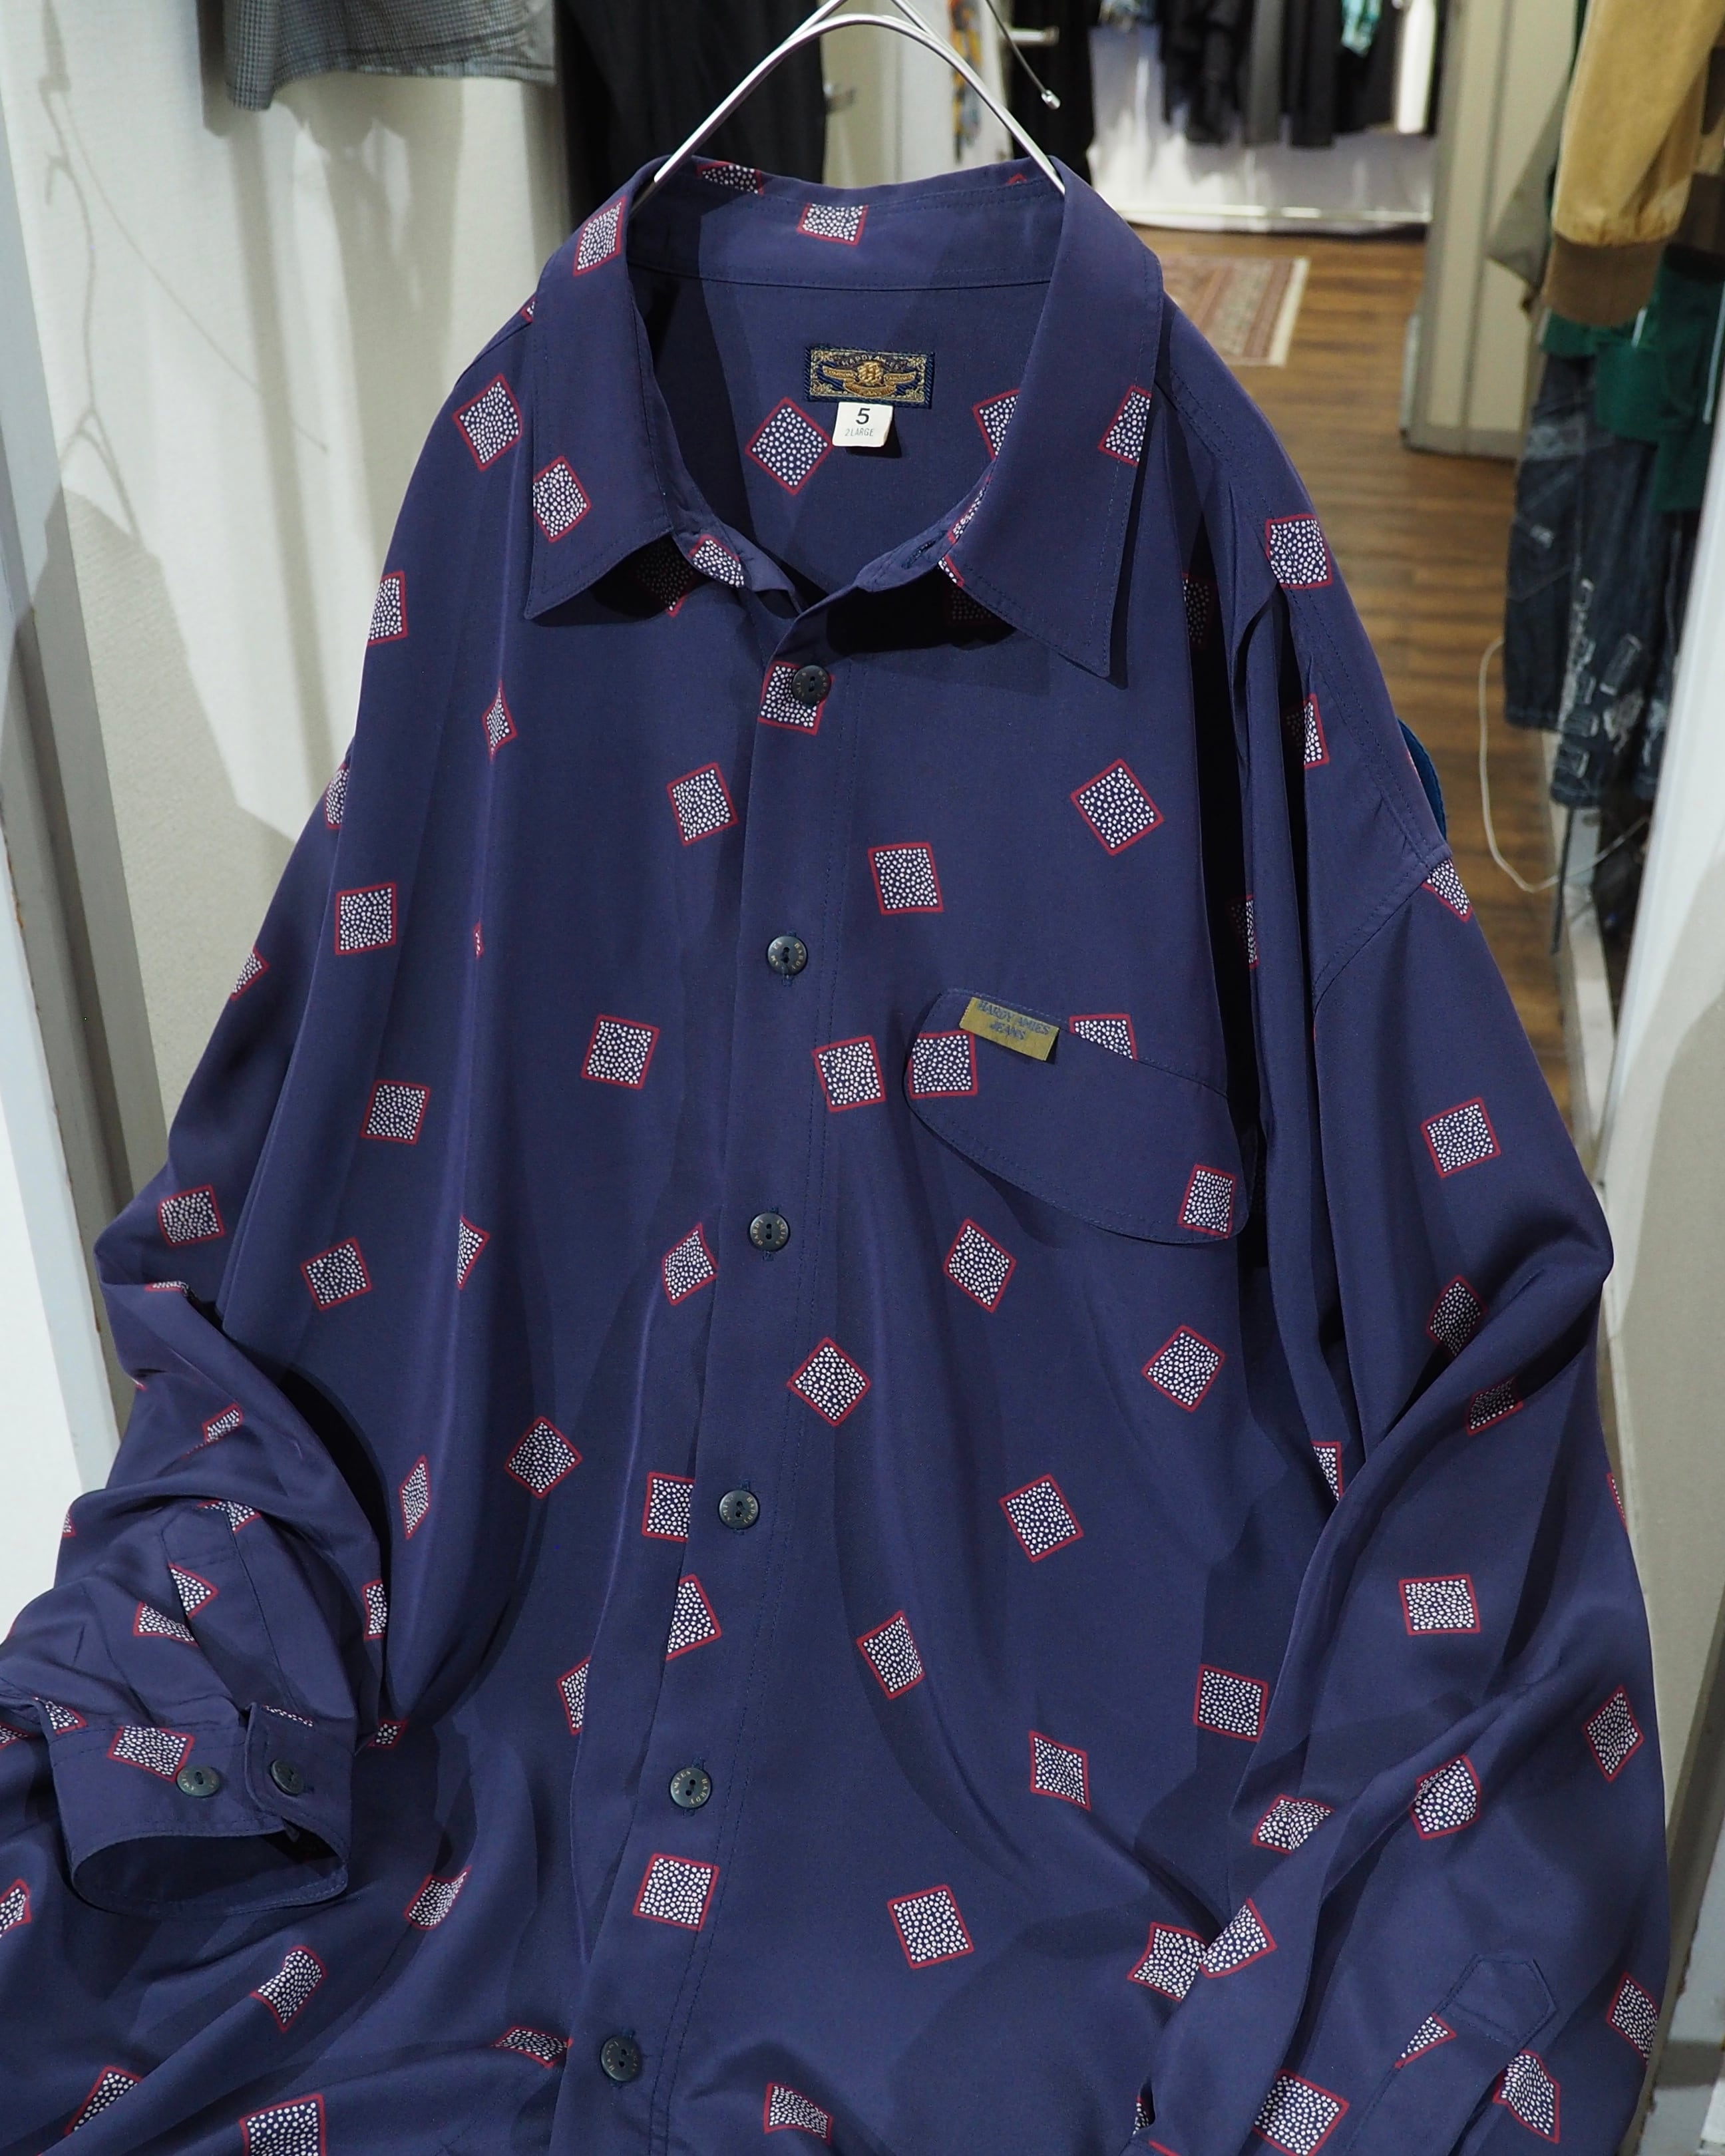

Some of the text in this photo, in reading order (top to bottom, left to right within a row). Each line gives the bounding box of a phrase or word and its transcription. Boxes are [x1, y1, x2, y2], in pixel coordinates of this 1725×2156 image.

[856, 408, 870, 425] 5
[845, 428, 874, 437] 2LARGE
[977, 999, 1012, 1023] HARDY
[989, 1022, 1026, 1039] JEANS
